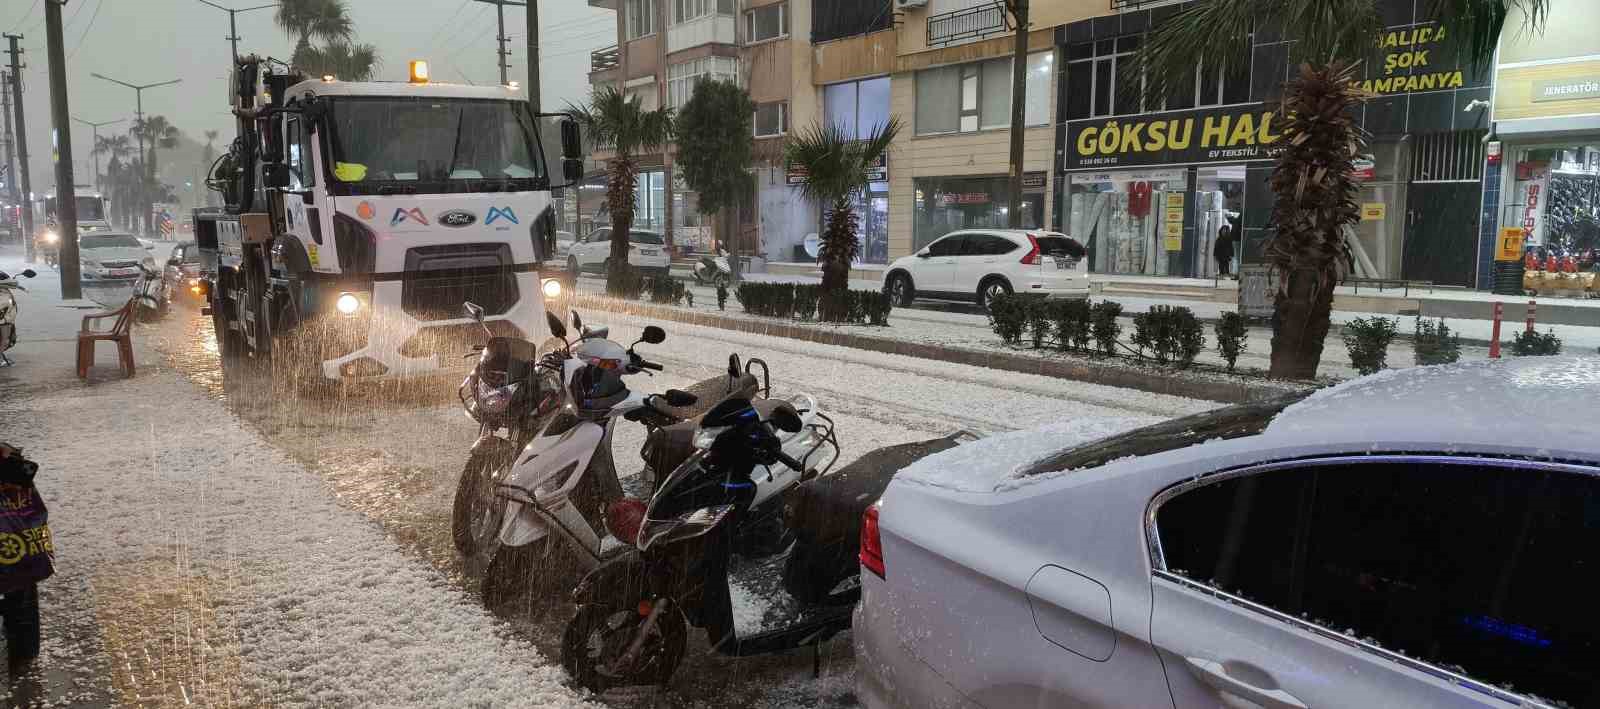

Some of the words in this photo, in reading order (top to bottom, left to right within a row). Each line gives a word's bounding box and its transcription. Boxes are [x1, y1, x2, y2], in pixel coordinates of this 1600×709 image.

[1377, 23, 1446, 48] ALIDA
[1384, 50, 1430, 75] ŞOK
[1543, 82, 1599, 96] JENERATÖR
[1077, 118, 1194, 156] GÖKSU
[1208, 149, 1220, 158] EV
[447, 213, 471, 224] Ford
